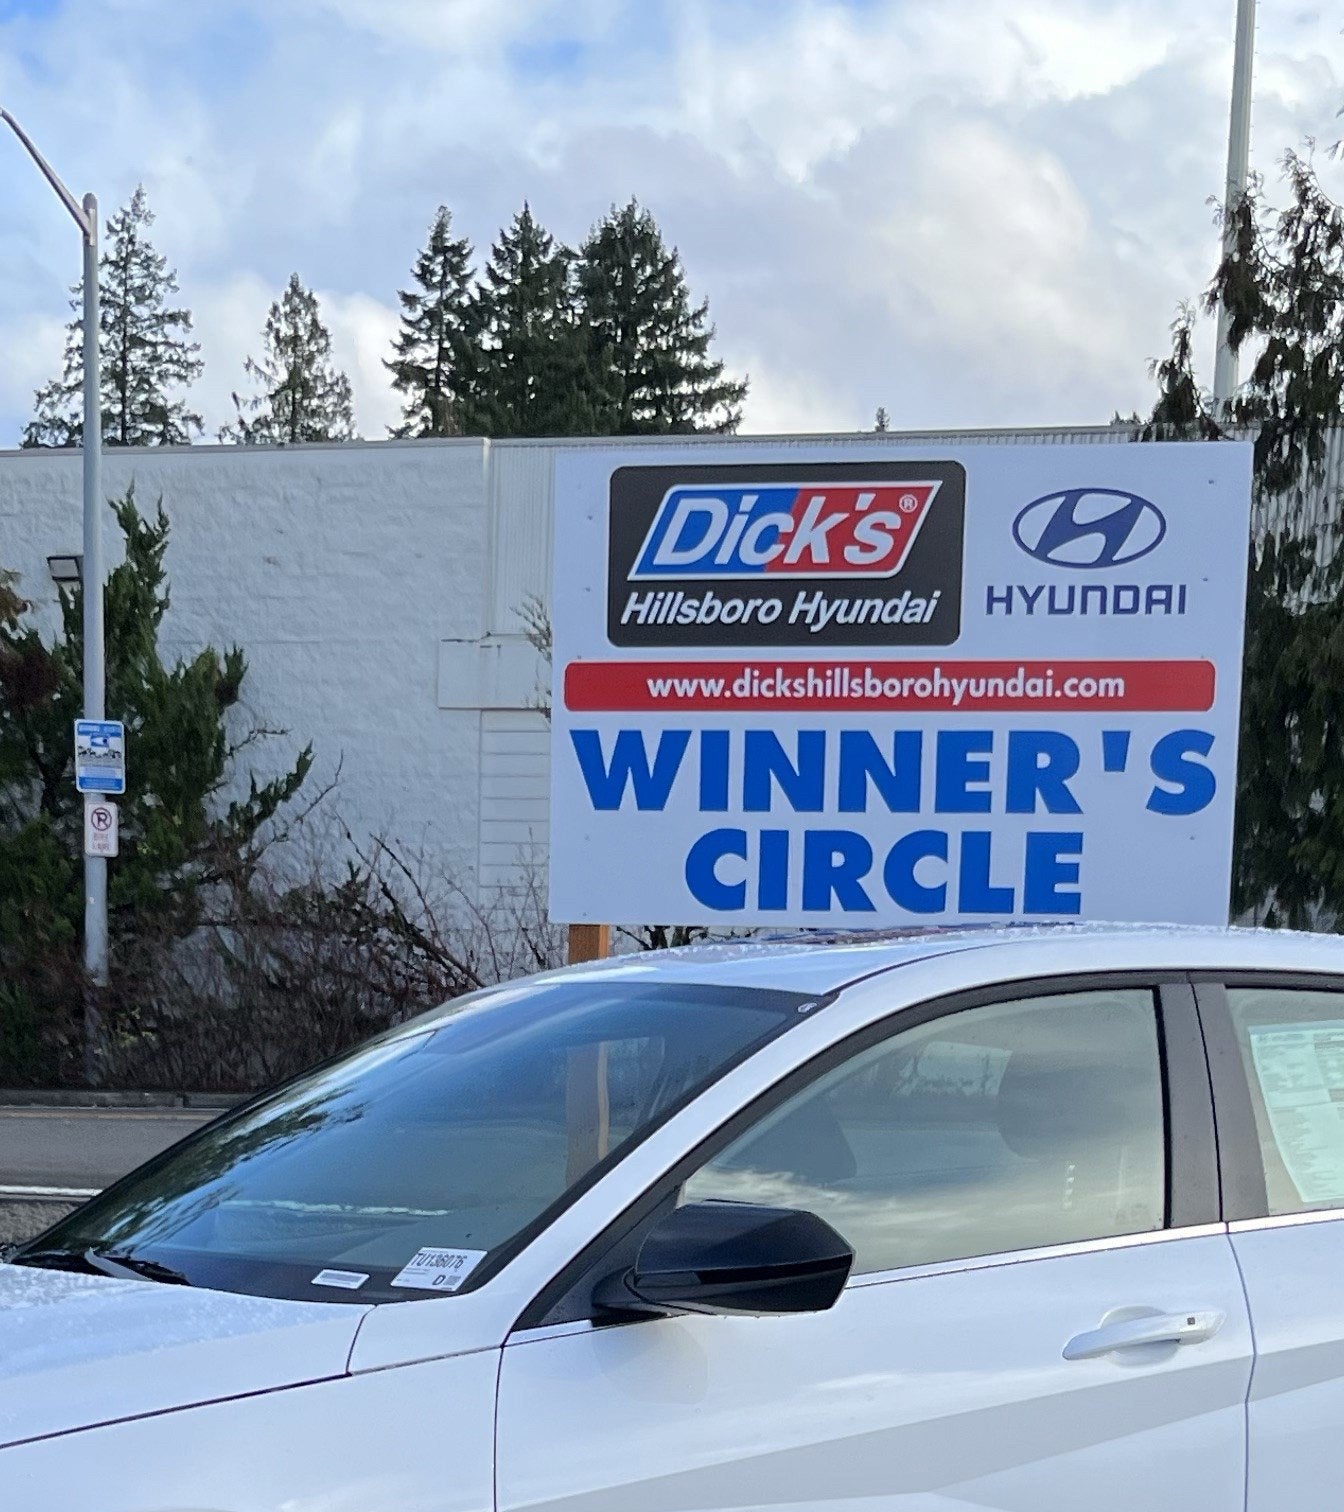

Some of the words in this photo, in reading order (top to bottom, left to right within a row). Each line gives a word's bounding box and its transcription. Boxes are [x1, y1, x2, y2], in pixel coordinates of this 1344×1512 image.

[620, 590, 783, 625] Hillsboro
[788, 590, 942, 633] Hyundai
[986, 584, 1186, 616] HYUNDAI
[647, 665, 1126, 706] www.dickshillsborohyundai.com
[569, 728, 1218, 816] WINNER'S
[684, 827, 1083, 915] CIRCLE
